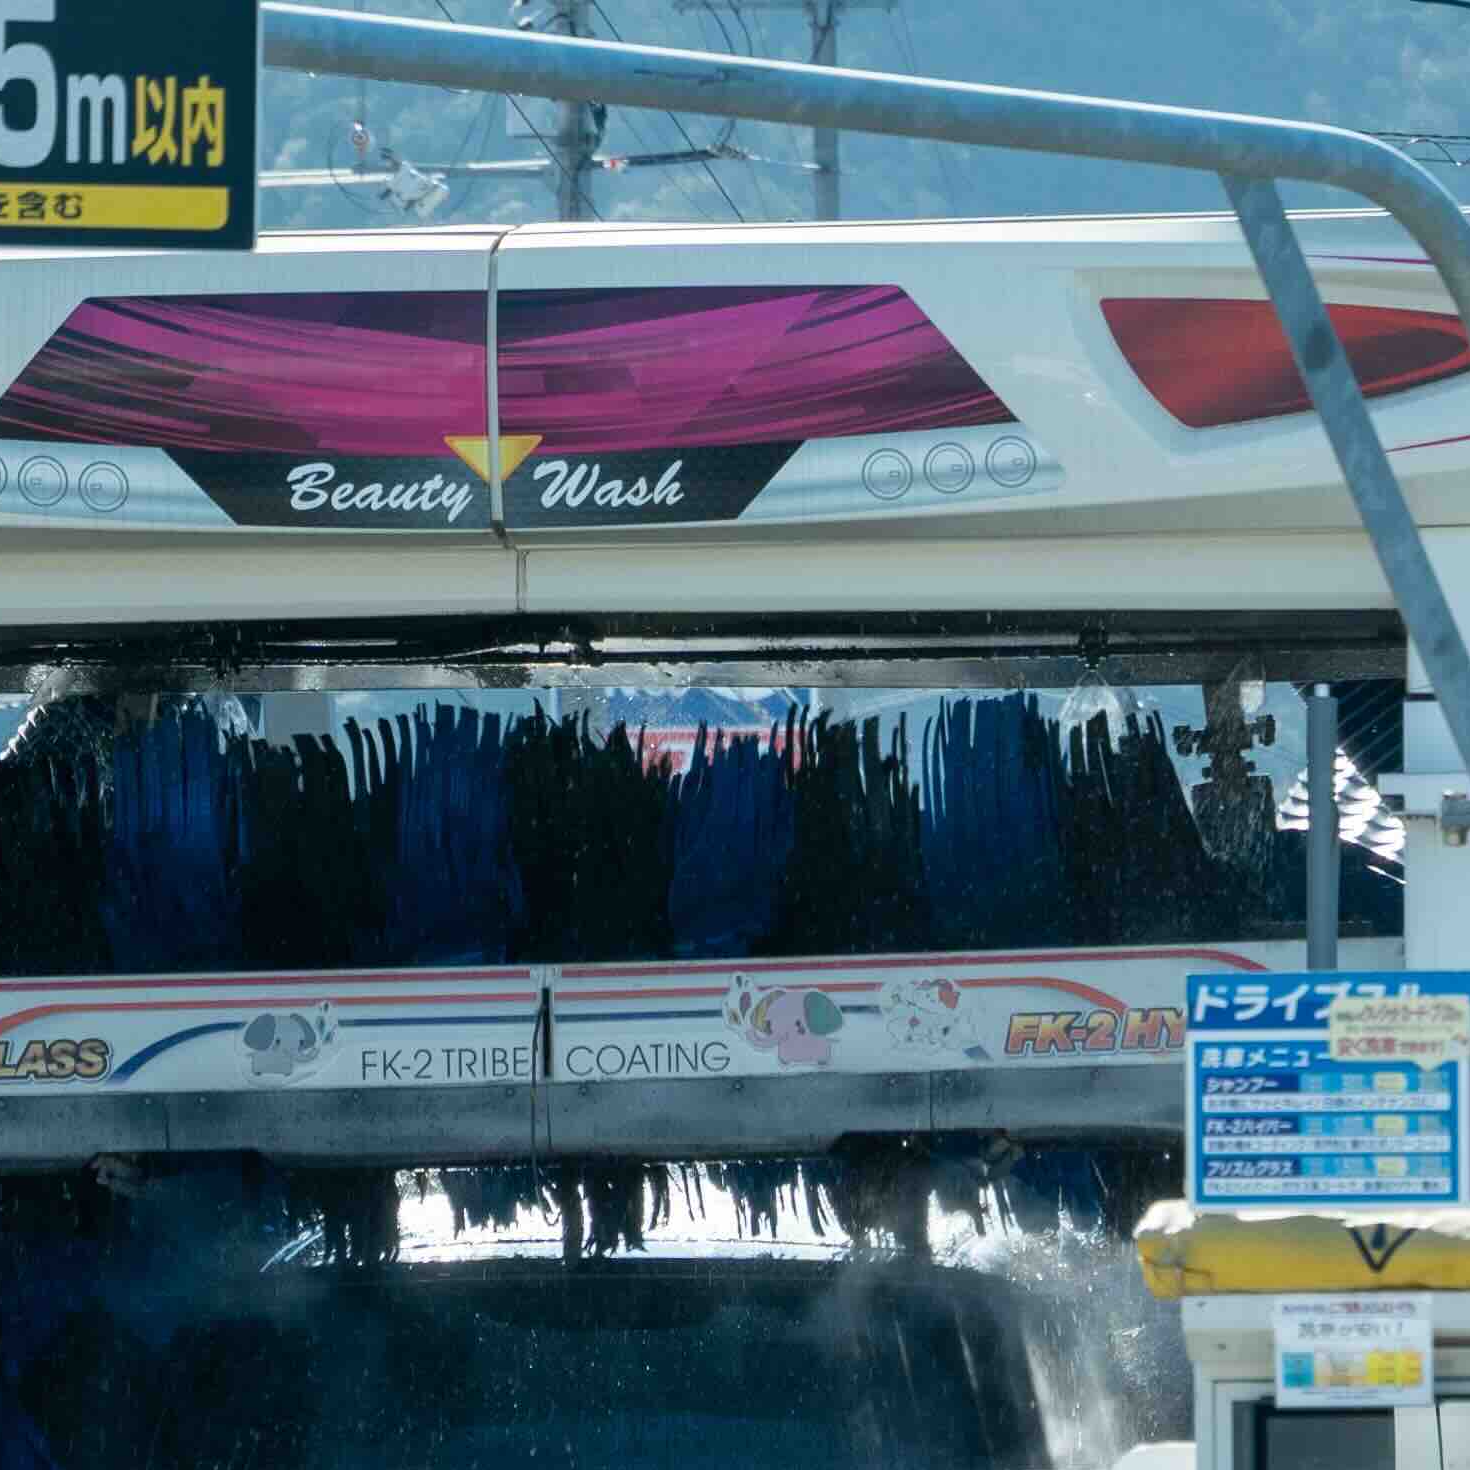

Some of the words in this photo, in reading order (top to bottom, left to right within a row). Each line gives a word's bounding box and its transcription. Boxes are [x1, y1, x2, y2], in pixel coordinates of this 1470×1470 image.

[286, 461, 473, 521] Beauty
[535, 457, 685, 508] Wash
[1004, 1010, 1120, 1054] FK-2
[362, 1047, 431, 1080] FK-2
[441, 1045, 529, 1078] TRIBE
[565, 1041, 731, 1077] COATING
